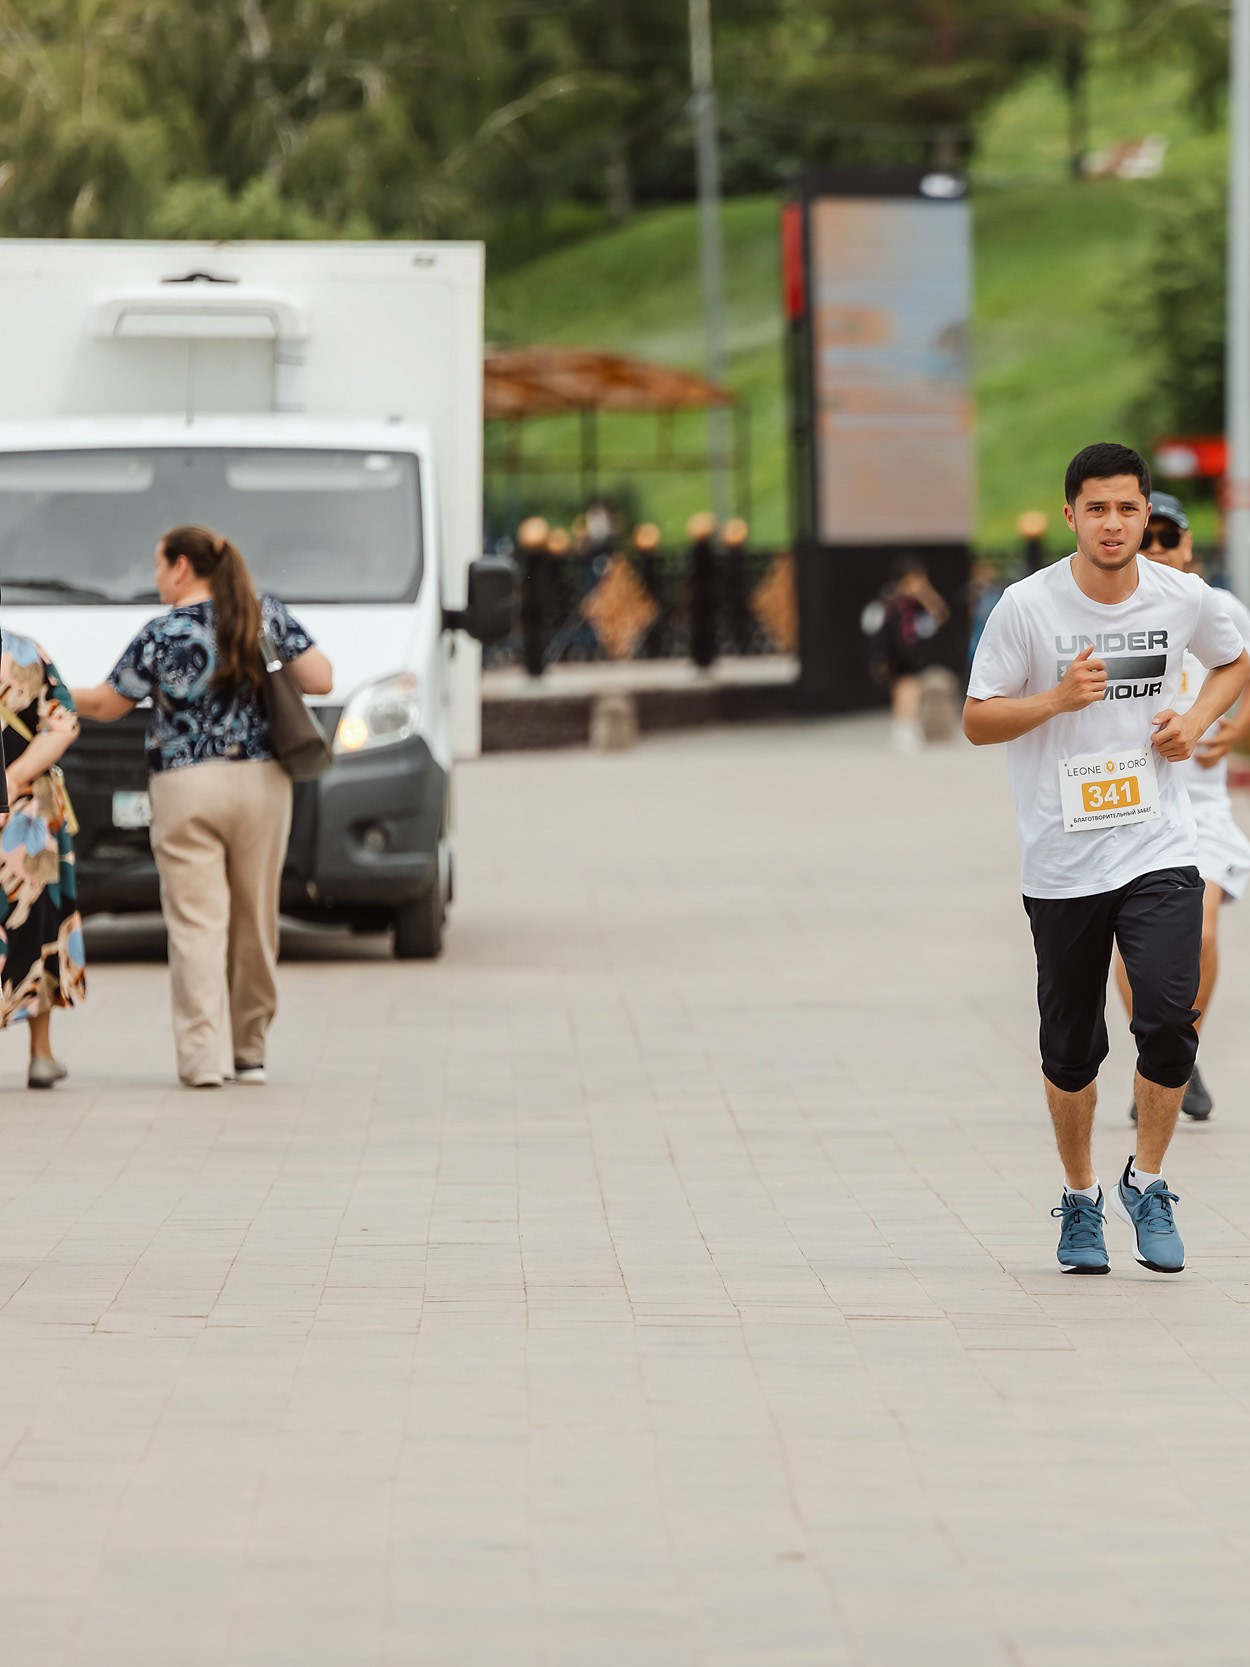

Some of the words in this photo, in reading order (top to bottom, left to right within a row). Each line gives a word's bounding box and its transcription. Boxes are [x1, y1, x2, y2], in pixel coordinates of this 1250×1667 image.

[1055, 630, 1168, 654] UNDER
[1103, 681, 1162, 700] MOUR
[1067, 765, 1102, 777] LEONE
[1119, 757, 1147, 771] D'ORO
[1088, 780, 1132, 808] 341
[1073, 809, 1136, 823] БЛАГОТВОРИТЕЛЬНЫЙ
[1136, 806, 1152, 815] ЗАБЕГ
